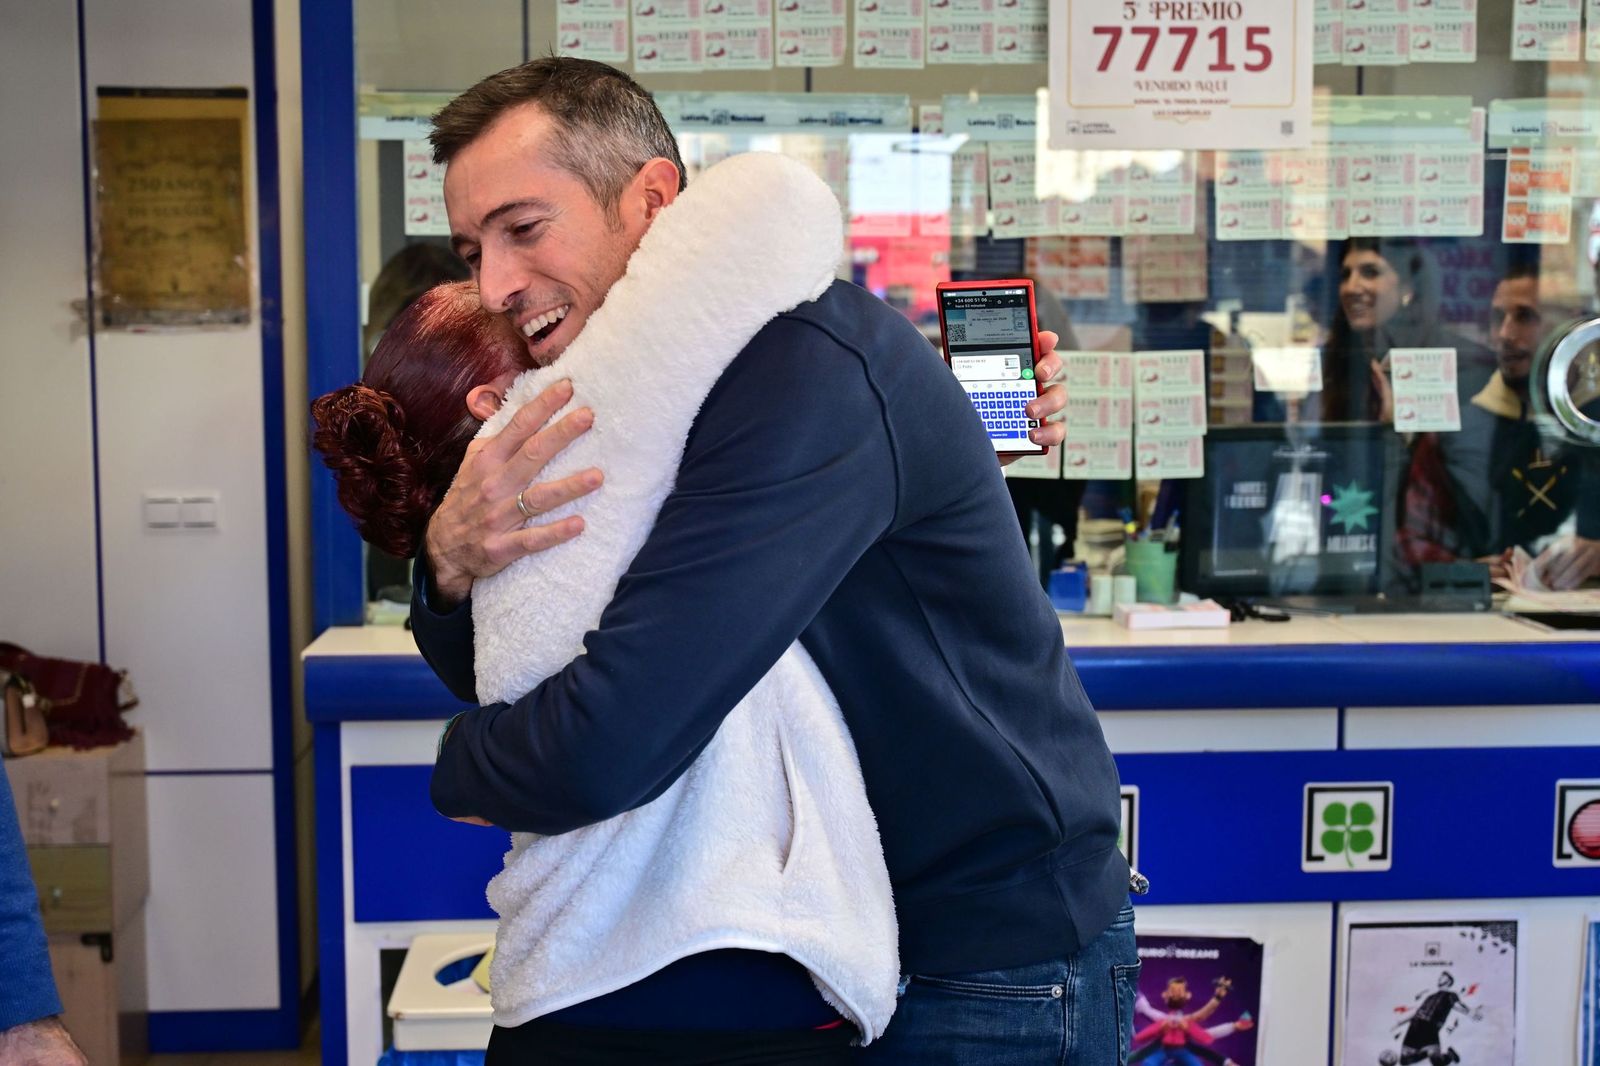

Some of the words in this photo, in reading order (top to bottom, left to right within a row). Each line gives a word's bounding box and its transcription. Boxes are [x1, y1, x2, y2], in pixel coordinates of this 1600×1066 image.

[1149, 0, 1243, 21] PREMIO
[1093, 26, 1273, 72] 77715
[1133, 80, 1191, 92] VENDIDO
[1174, 949, 1219, 960] DREAMS
